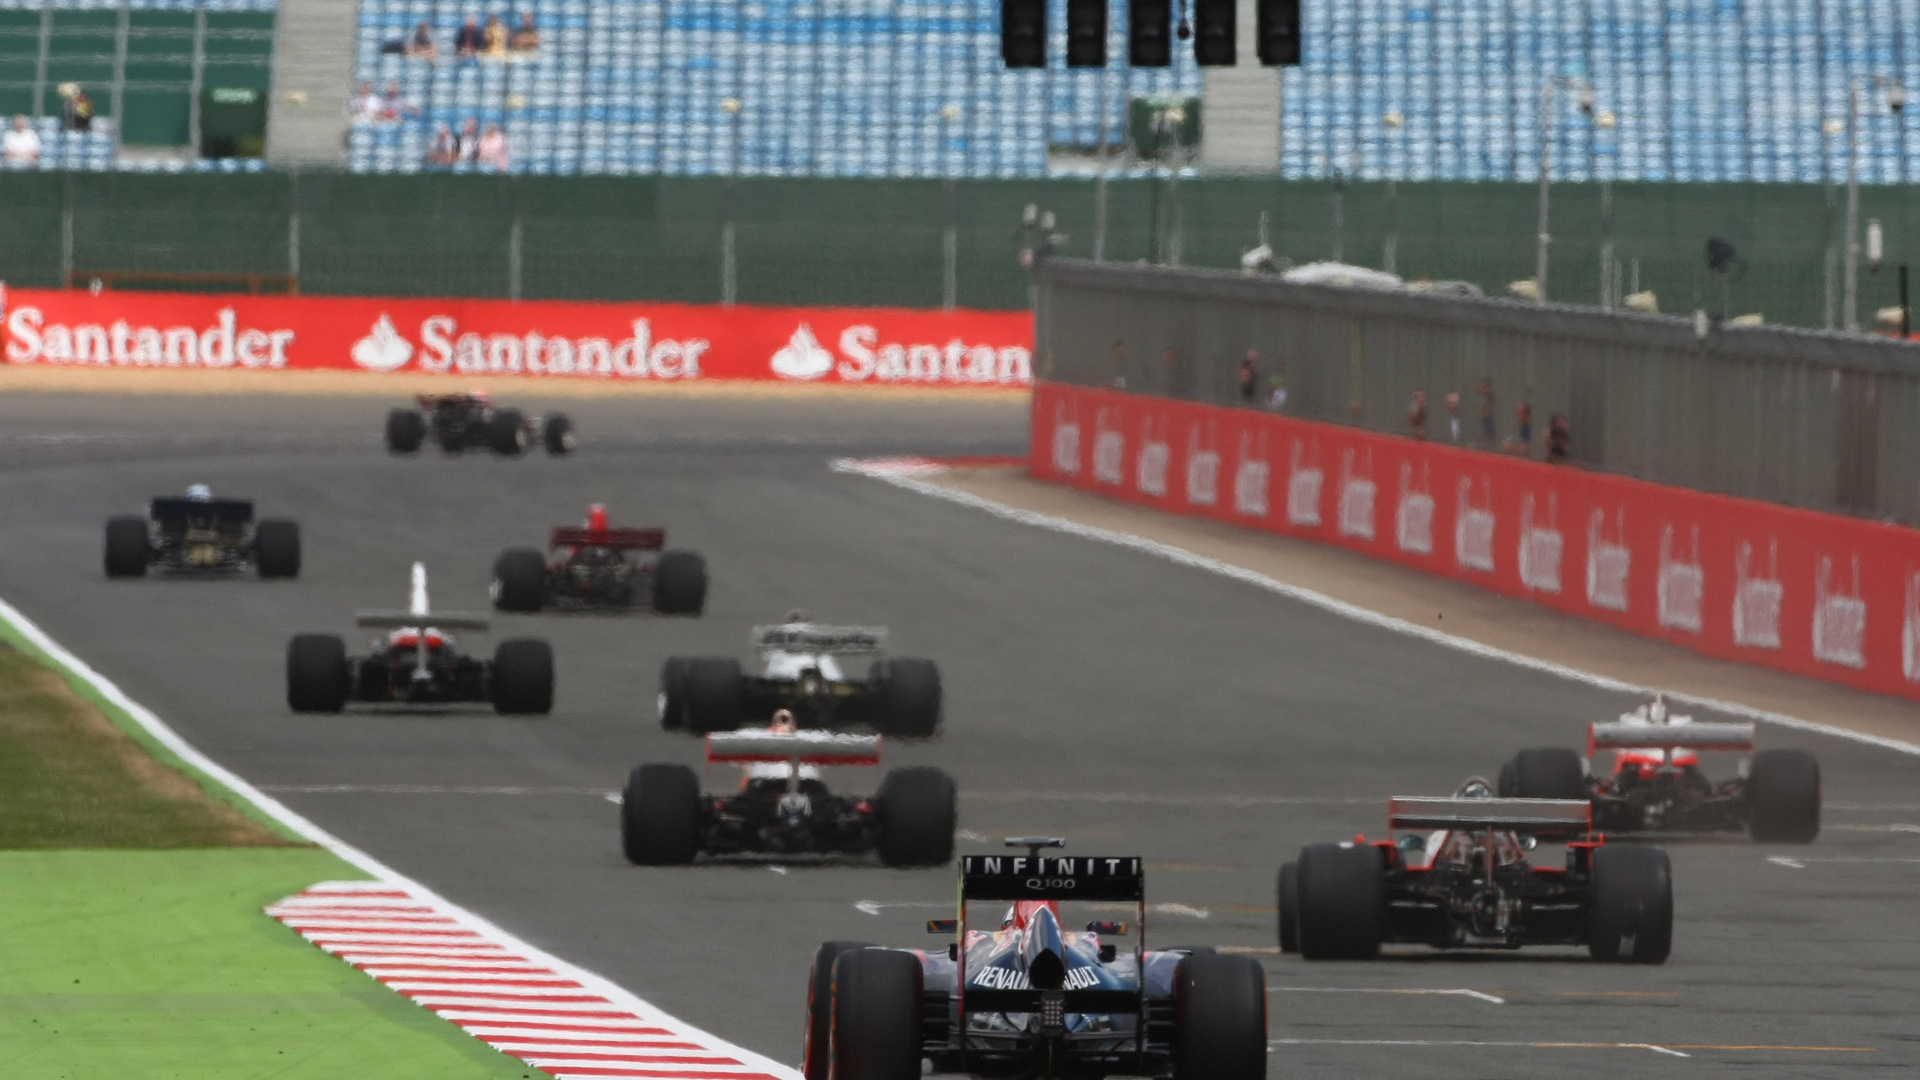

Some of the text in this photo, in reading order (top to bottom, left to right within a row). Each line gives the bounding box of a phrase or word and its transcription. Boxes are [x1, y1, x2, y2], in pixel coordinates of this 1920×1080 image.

[5, 306, 295, 366] Santander
[419, 315, 710, 377] Santander
[838, 324, 1034, 382] Santan
[965, 857, 1138, 875] INFINITI
[1026, 878, 1076, 889] Q100
